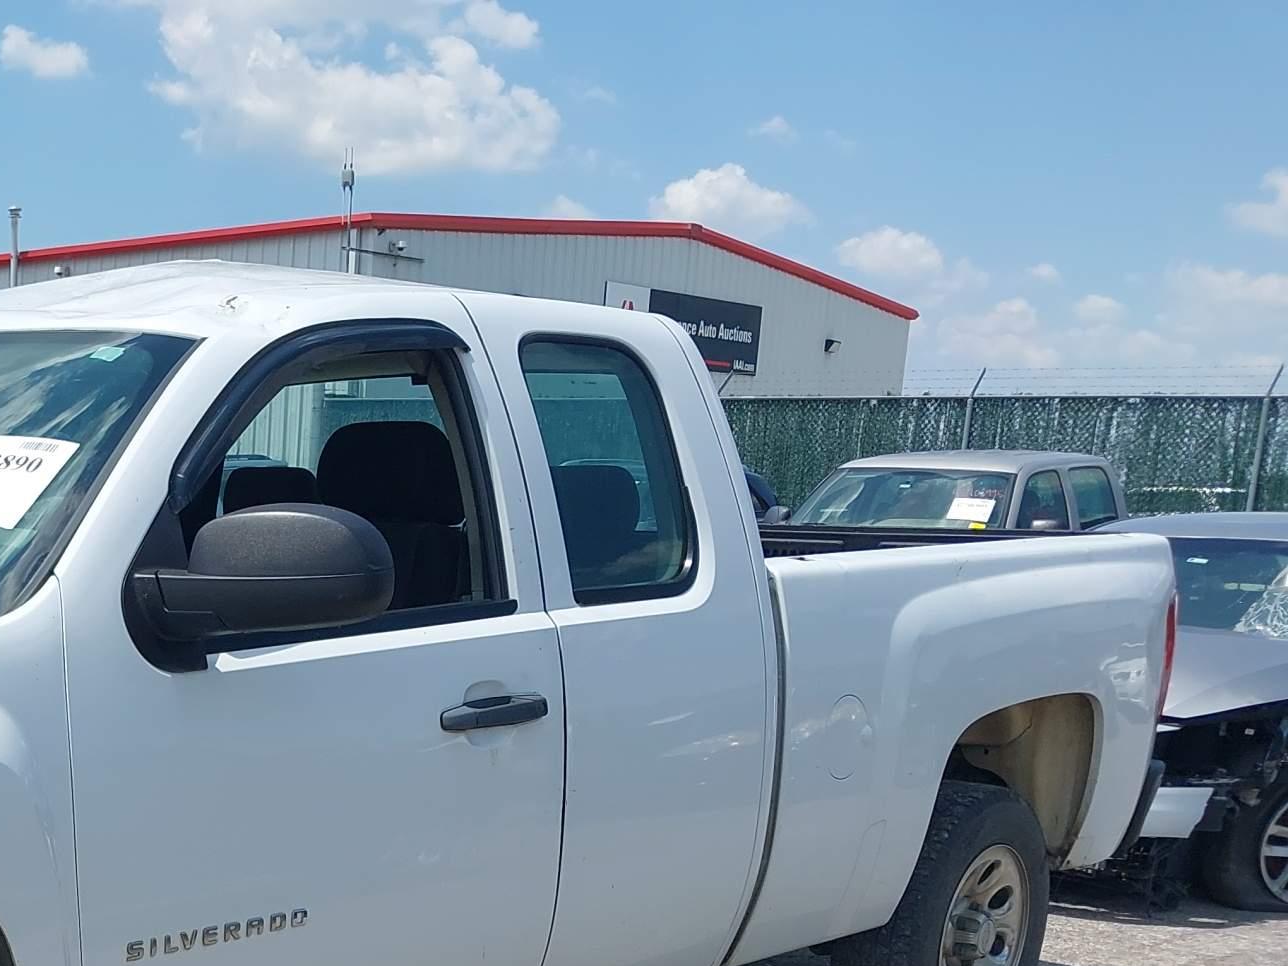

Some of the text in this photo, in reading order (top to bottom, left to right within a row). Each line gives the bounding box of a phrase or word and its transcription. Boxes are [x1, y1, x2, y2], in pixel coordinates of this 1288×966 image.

[698, 320, 717, 338] Auto
[718, 323, 753, 343] Auctions
[126, 908, 308, 962] SILVERADO
